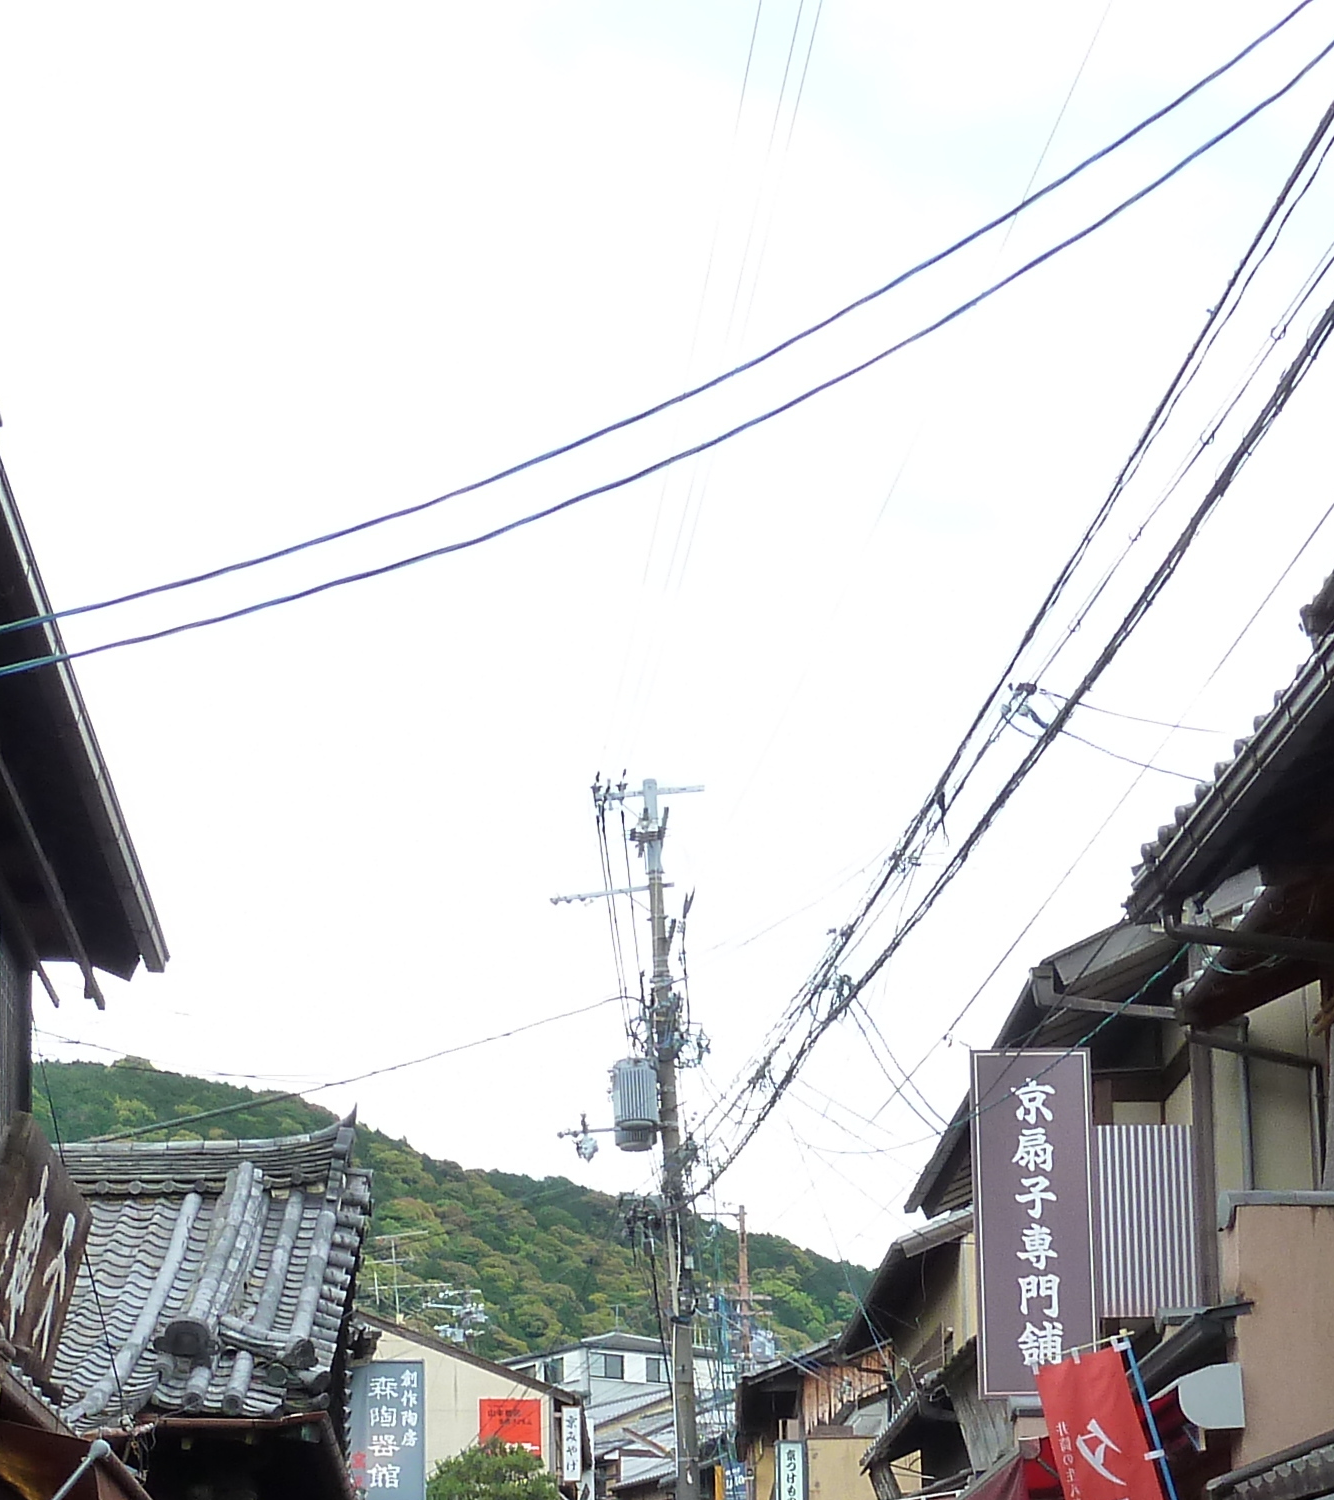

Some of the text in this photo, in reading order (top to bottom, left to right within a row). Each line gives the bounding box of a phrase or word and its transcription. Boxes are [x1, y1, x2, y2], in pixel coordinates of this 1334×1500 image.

[1010, 1076, 1063, 1367] 京扇子専門舗
[367, 1376, 401, 1488] 森陶器館
[400, 1368, 418, 1446] 創作陶房
[565, 1415, 579, 1472] 京みやげ
